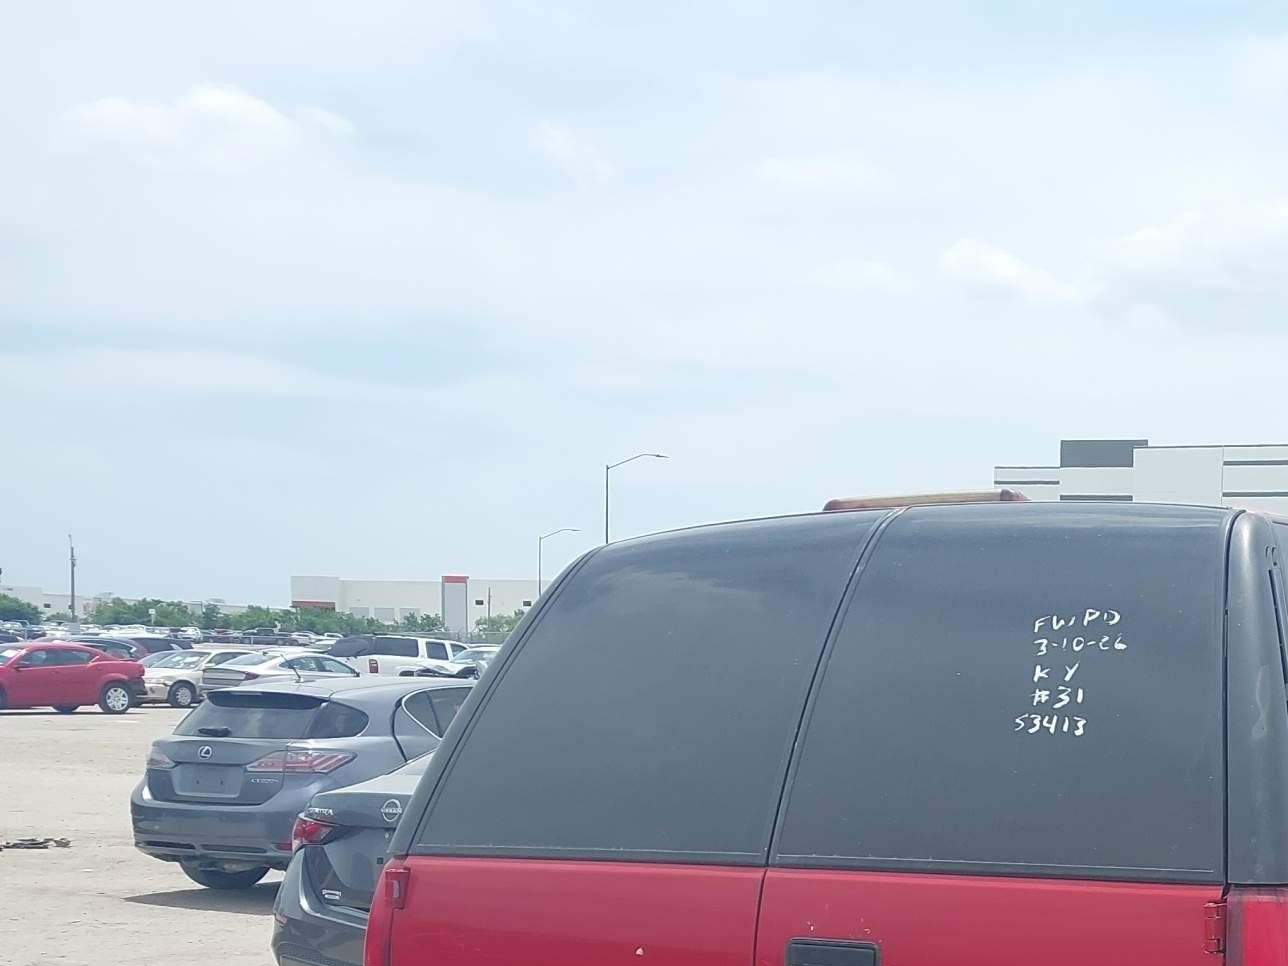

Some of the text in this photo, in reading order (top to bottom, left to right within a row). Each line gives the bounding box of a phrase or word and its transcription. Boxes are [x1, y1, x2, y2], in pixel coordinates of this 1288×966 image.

[1033, 633, 1128, 656] 3-10-26
[1030, 686, 1084, 708] #31
[1014, 713, 1087, 736] 53413
